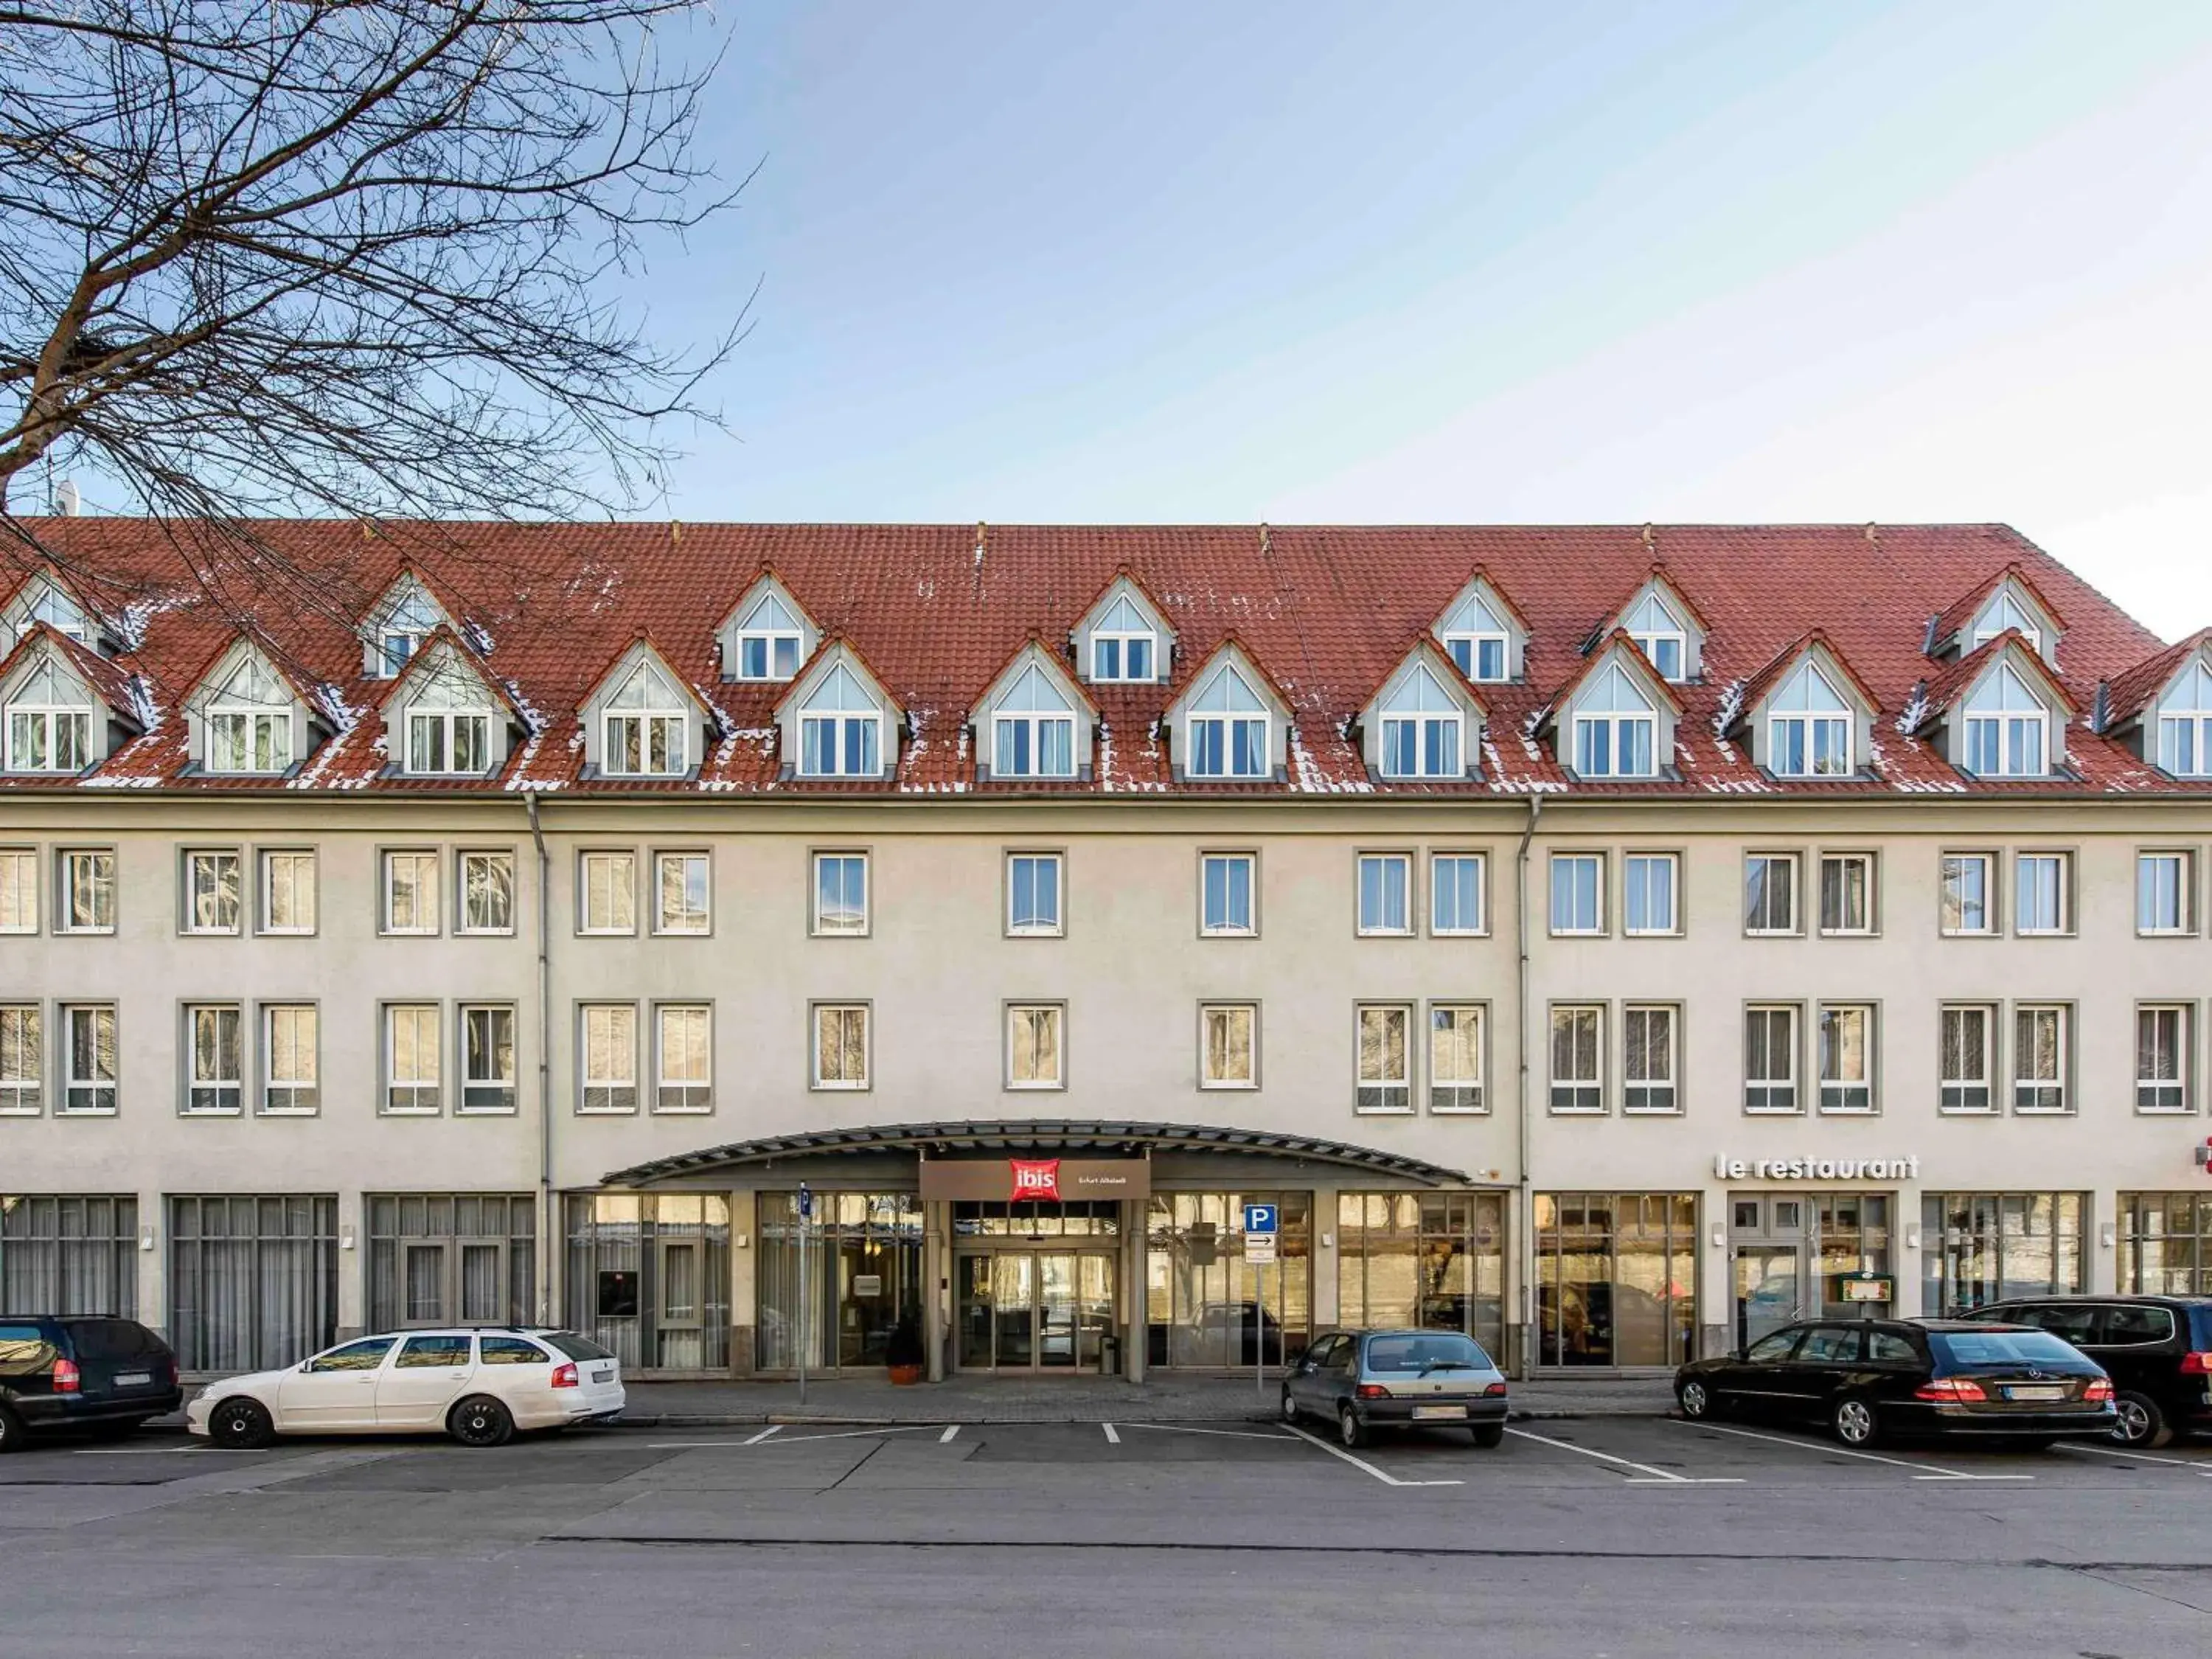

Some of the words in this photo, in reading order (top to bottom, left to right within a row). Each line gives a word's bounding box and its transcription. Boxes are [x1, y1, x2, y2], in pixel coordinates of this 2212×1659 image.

[1715, 1152, 1745, 1179] le
[1753, 1155, 1919, 1180] restaurant
[1017, 1169, 1054, 1187] ibis
[1251, 1208, 1269, 1229] P
